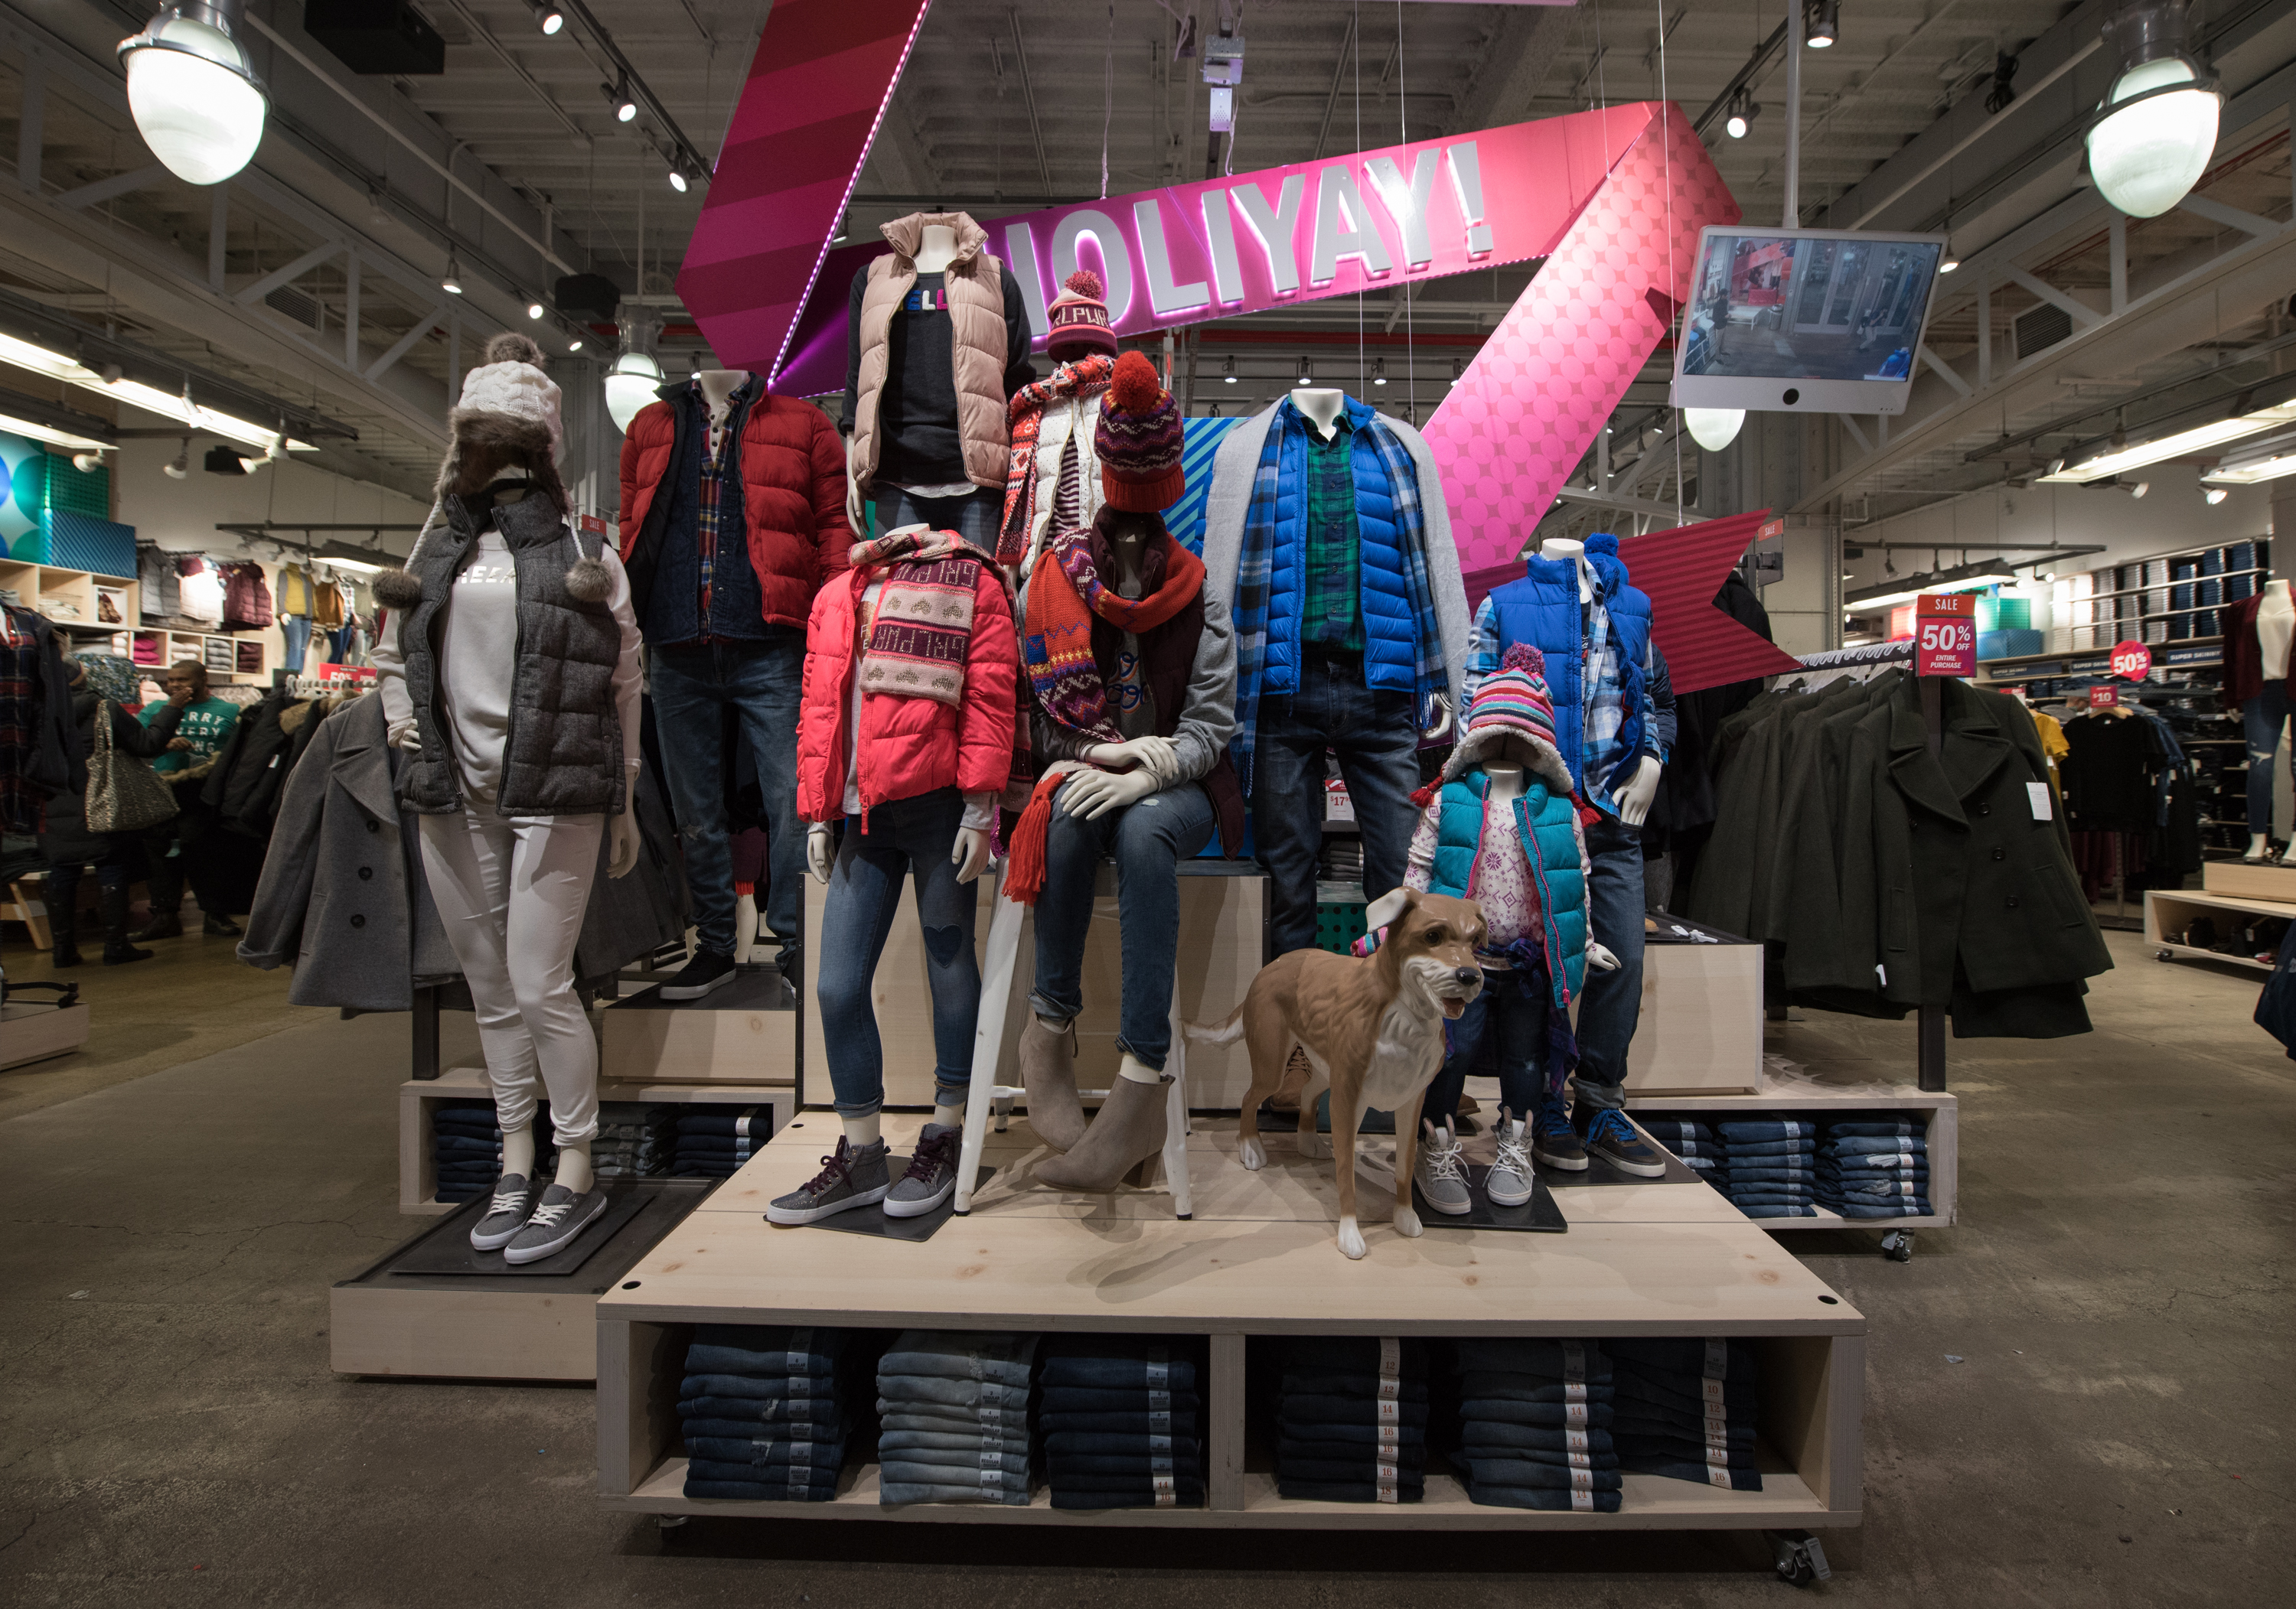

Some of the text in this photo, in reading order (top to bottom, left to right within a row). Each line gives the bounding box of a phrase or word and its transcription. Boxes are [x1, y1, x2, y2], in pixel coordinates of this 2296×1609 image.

[896, 289, 948, 311] ELL
[589, 519, 599, 530] SALE
[1765, 524, 1775, 536] SALE
[1935, 598, 1958, 611] SALE
[1921, 624, 1971, 650] 50%
[2113, 652, 2148, 674] 50%
[2092, 692, 2112, 702] $10
[180, 711, 224, 726] RRY
[1385, 1361, 1394, 1370] 12
[1707, 1386, 1718, 1394] 10
[1383, 1405, 1392, 1413] 14
[1571, 1407, 1582, 1415] 14
[1710, 1405, 1720, 1413] 12
[1710, 1422, 1720, 1430] 14
[1384, 1428, 1394, 1436] 16
[1572, 1437, 1582, 1446] 14
[1711, 1448, 1721, 1457] 14
[1382, 1467, 1392, 1476] 16
[1714, 1472, 1725, 1481] 16
[1381, 1486, 1391, 1494] 18
[1160, 1492, 1170, 1501] 16
